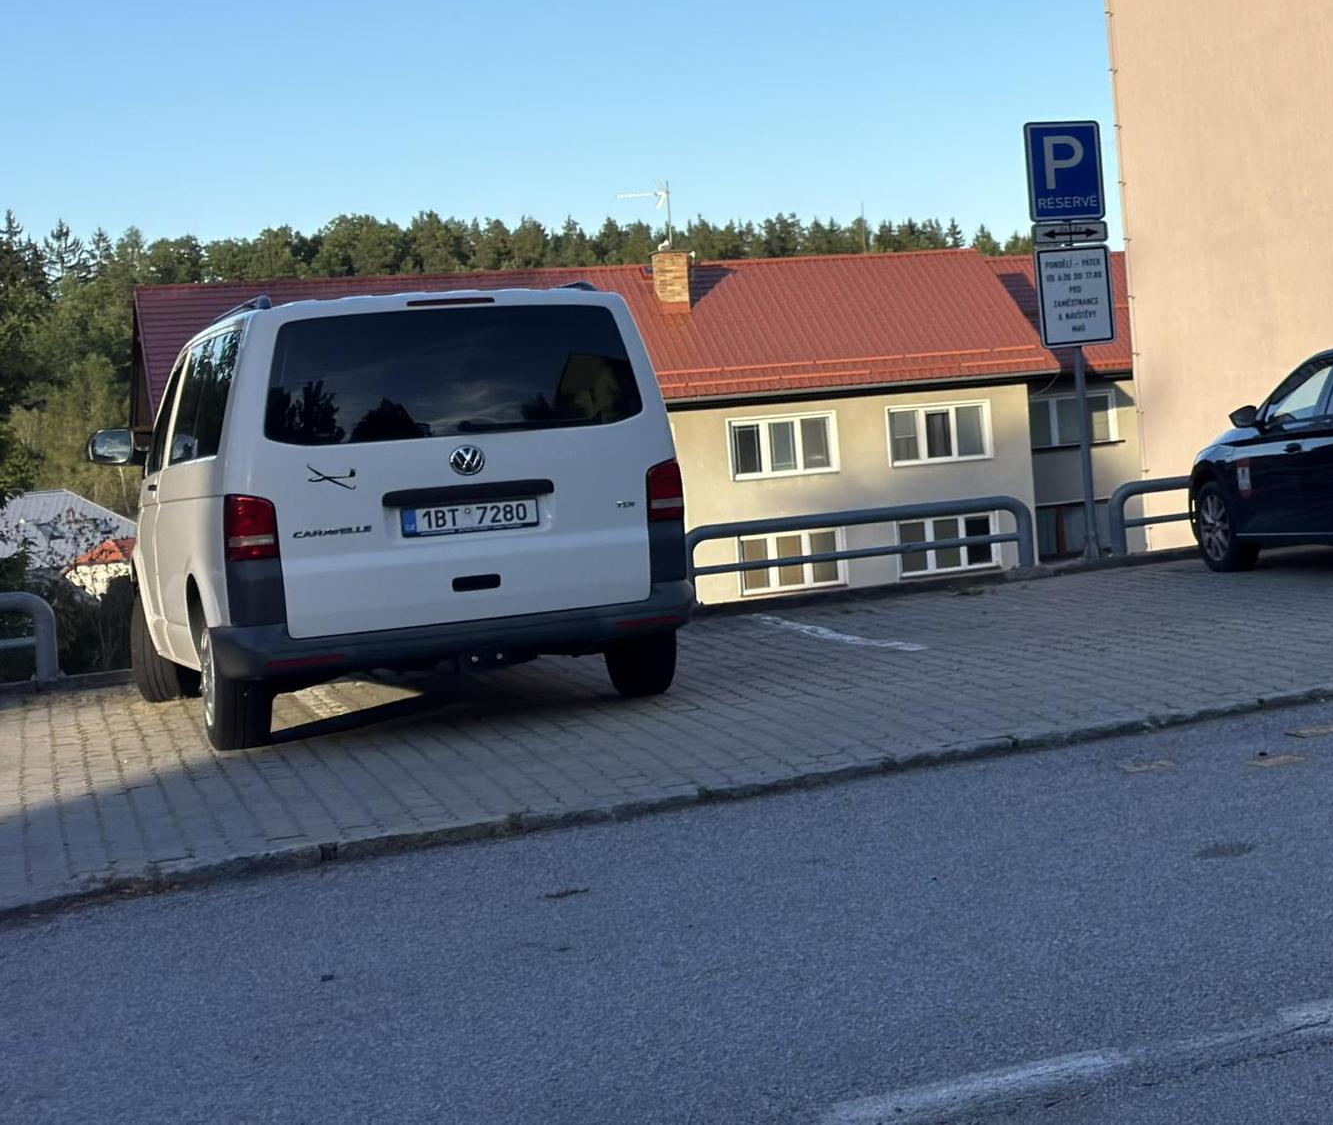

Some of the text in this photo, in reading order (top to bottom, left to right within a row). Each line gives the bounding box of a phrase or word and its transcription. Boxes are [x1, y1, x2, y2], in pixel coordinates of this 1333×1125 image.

[1042, 135, 1085, 190] P
[421, 503, 528, 529] 1BT 7280
[292, 524, 372, 539] CARAVELLE
